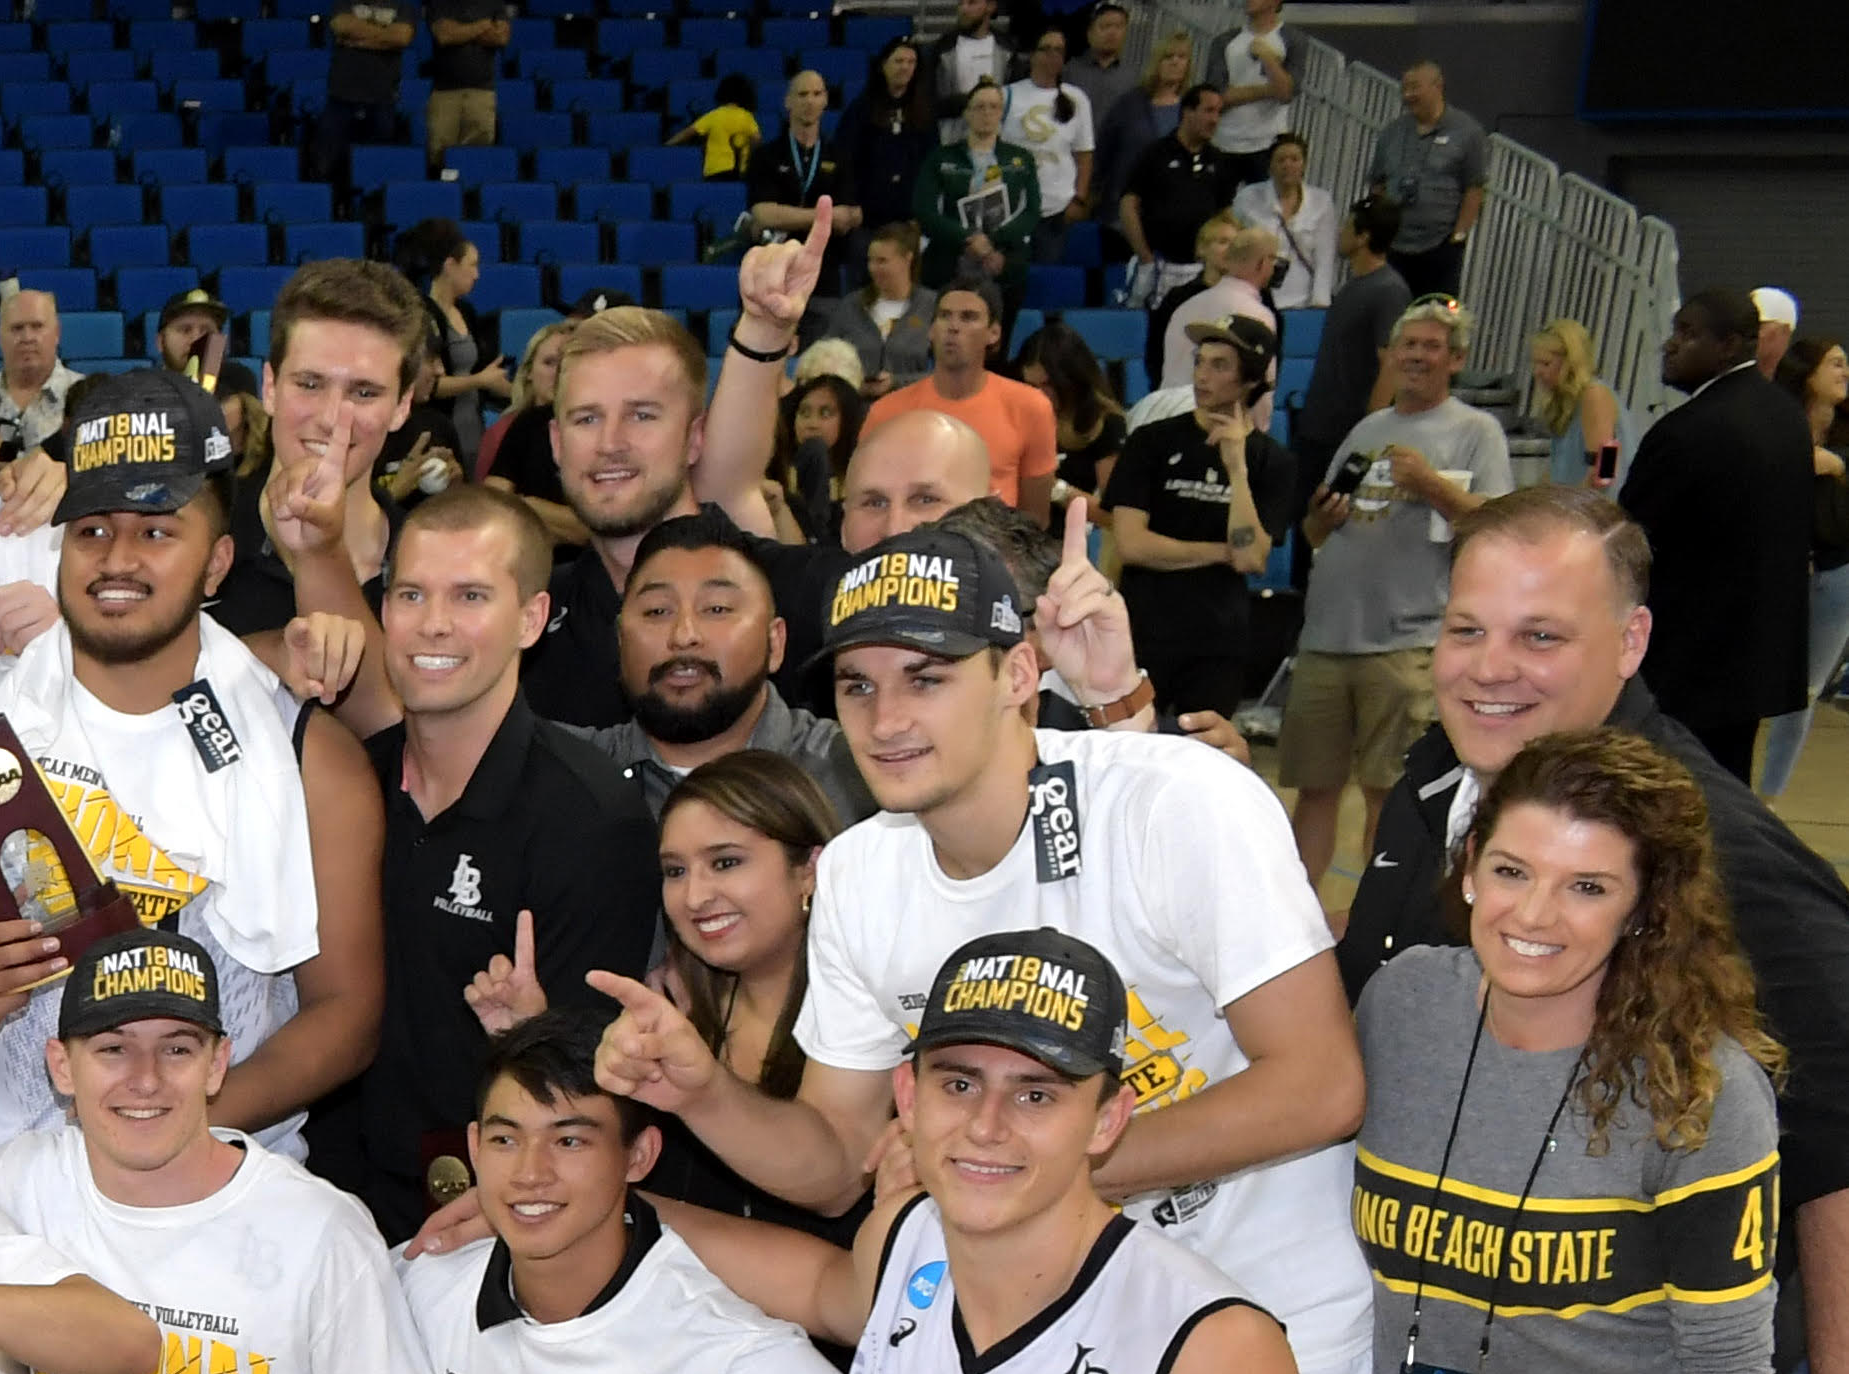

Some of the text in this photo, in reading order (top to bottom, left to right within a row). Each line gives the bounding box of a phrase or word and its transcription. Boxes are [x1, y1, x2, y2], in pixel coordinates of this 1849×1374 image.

[178, 691, 244, 764] gear
[1028, 777, 1082, 878] gear
[448, 853, 482, 906] LB
[433, 895, 494, 922] VOLLEYBALL
[95, 964, 206, 1001] CHAMPIONS
[944, 975, 1089, 1032] CHAMPIONS
[1405, 1203, 1504, 1279] BEACH
[1509, 1227, 1617, 1285] STATE
[155, 1305, 240, 1336] VOLLEYBALL
